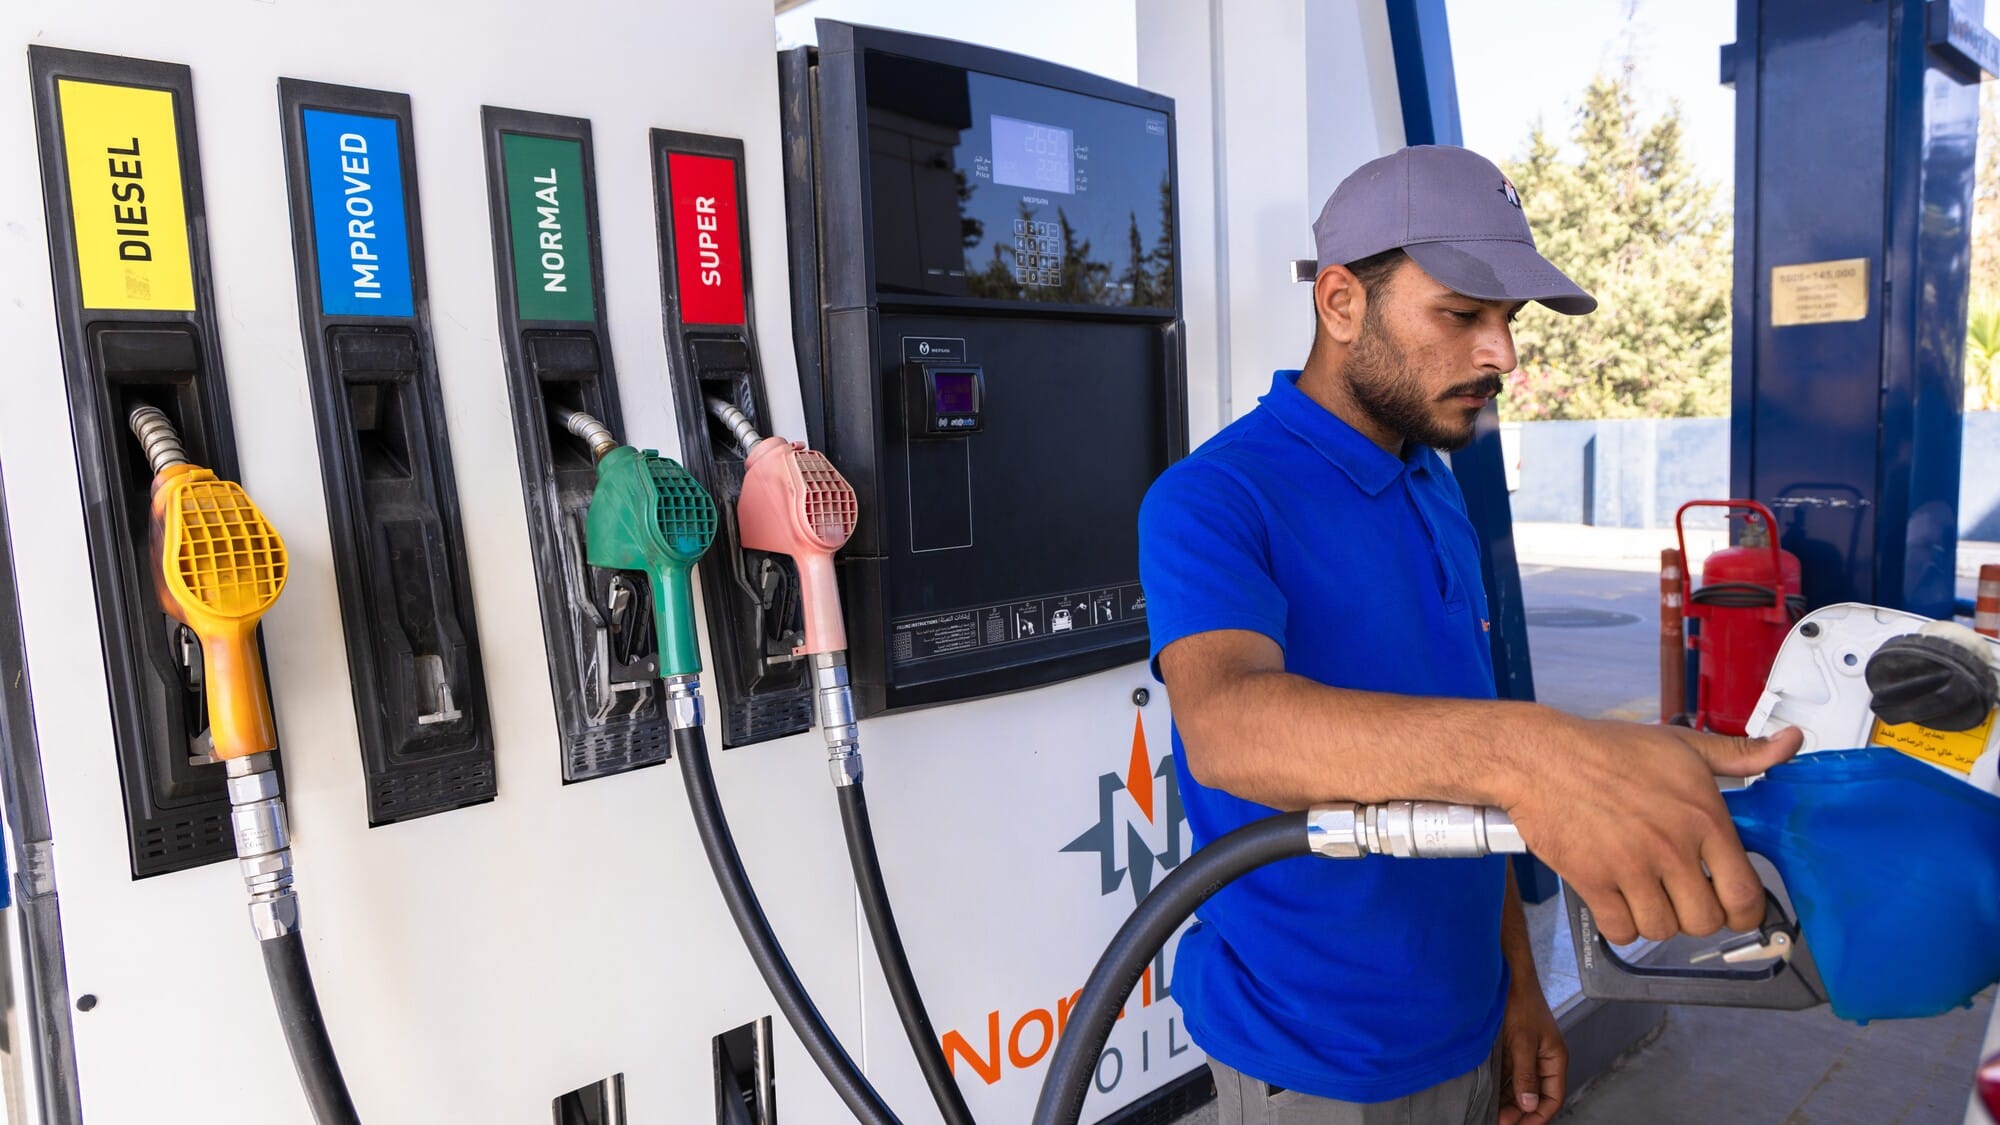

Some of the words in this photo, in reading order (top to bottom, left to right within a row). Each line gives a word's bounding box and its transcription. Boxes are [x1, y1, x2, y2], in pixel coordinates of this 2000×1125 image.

[108, 138, 151, 261] DIESEL
[975, 170, 990, 179] Price
[976, 164, 989, 172] Unit
[340, 134, 380, 299] IMPROVED
[534, 168, 566, 292] NORMAL
[695, 197, 721, 286] SUPER
[1880, 728, 1895, 738] فقط
[1094, 1017, 1189, 1094] OIL
